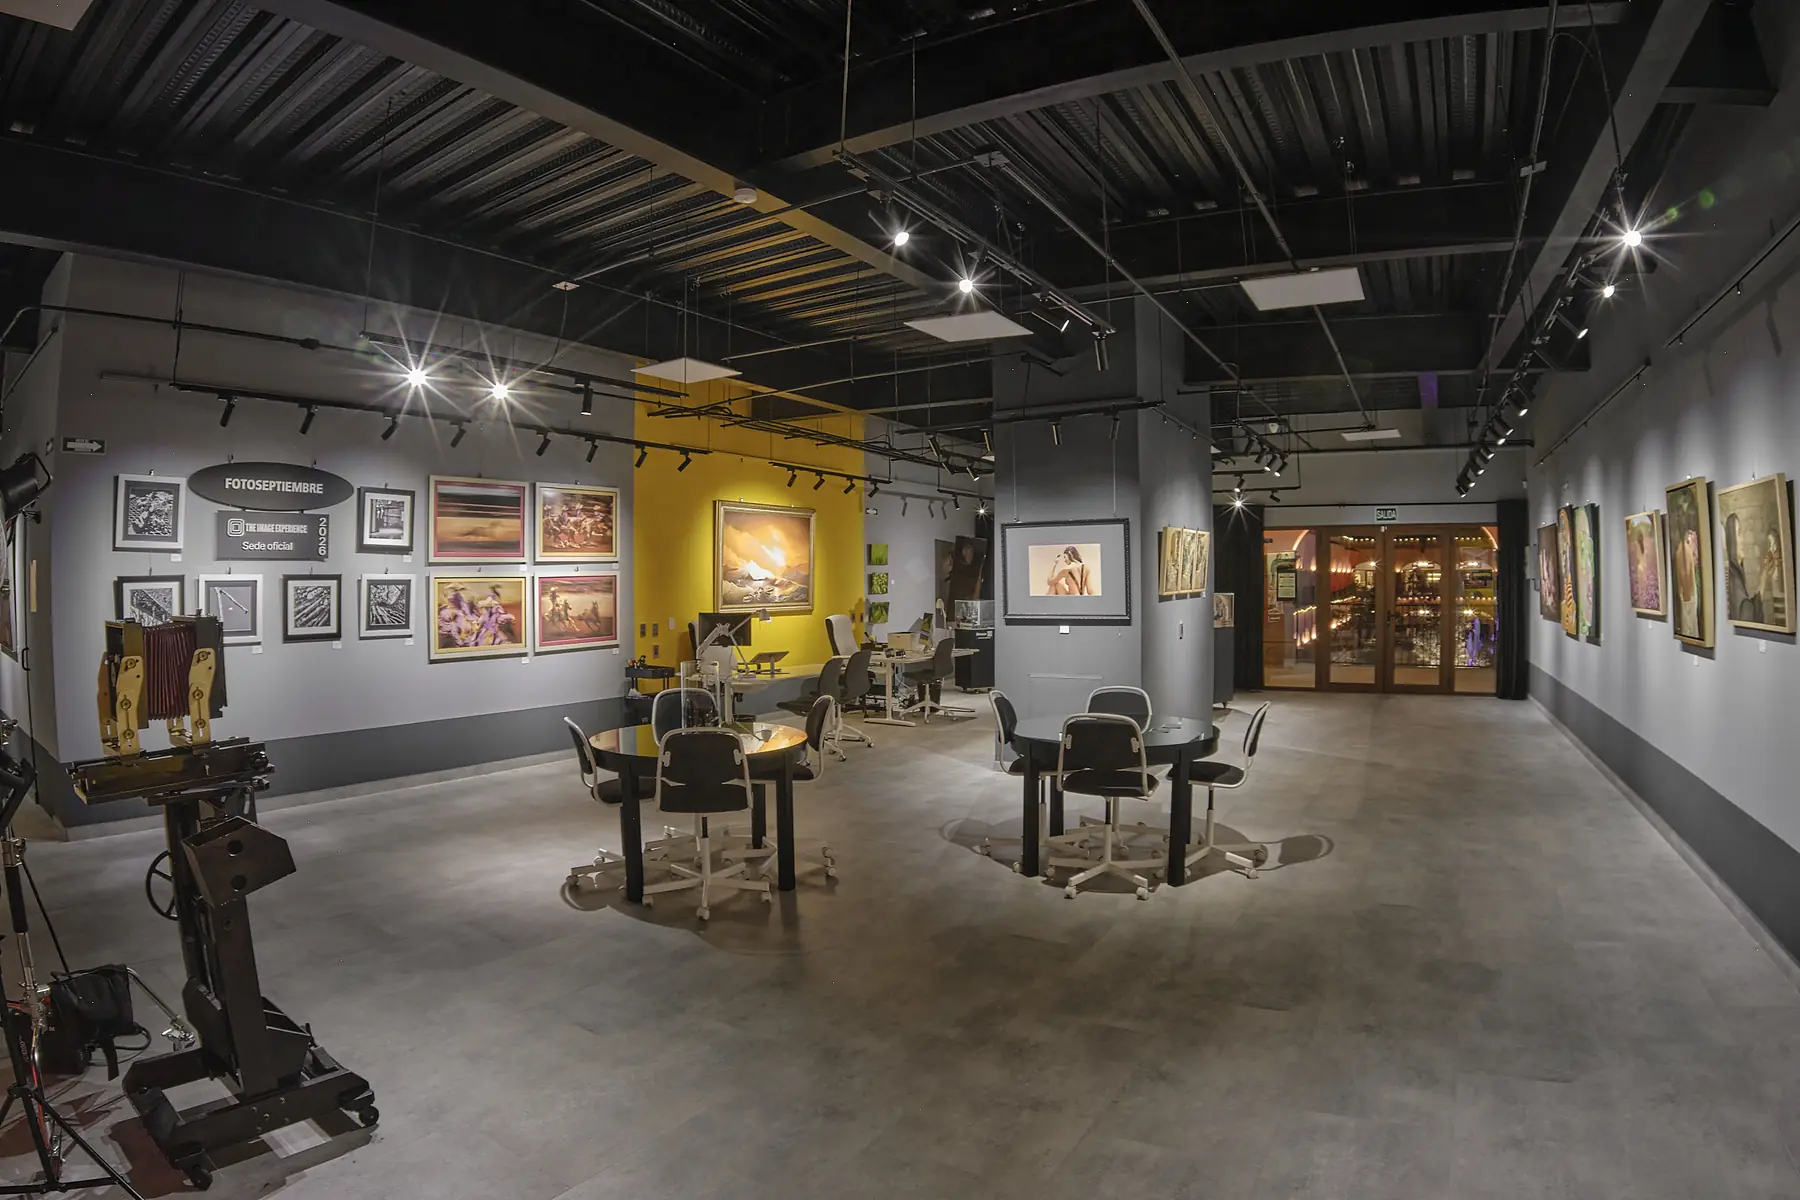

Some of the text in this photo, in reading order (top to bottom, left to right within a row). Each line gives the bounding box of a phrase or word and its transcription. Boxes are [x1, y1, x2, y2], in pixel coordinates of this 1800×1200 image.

[225, 478, 323, 494] FOTOSEPTIEMBRE
[1376, 510, 1396, 519] SALIDA
[245, 523, 257, 533] THE
[318, 517, 327, 556] 2026
[242, 541, 294, 551] Sede oficial
